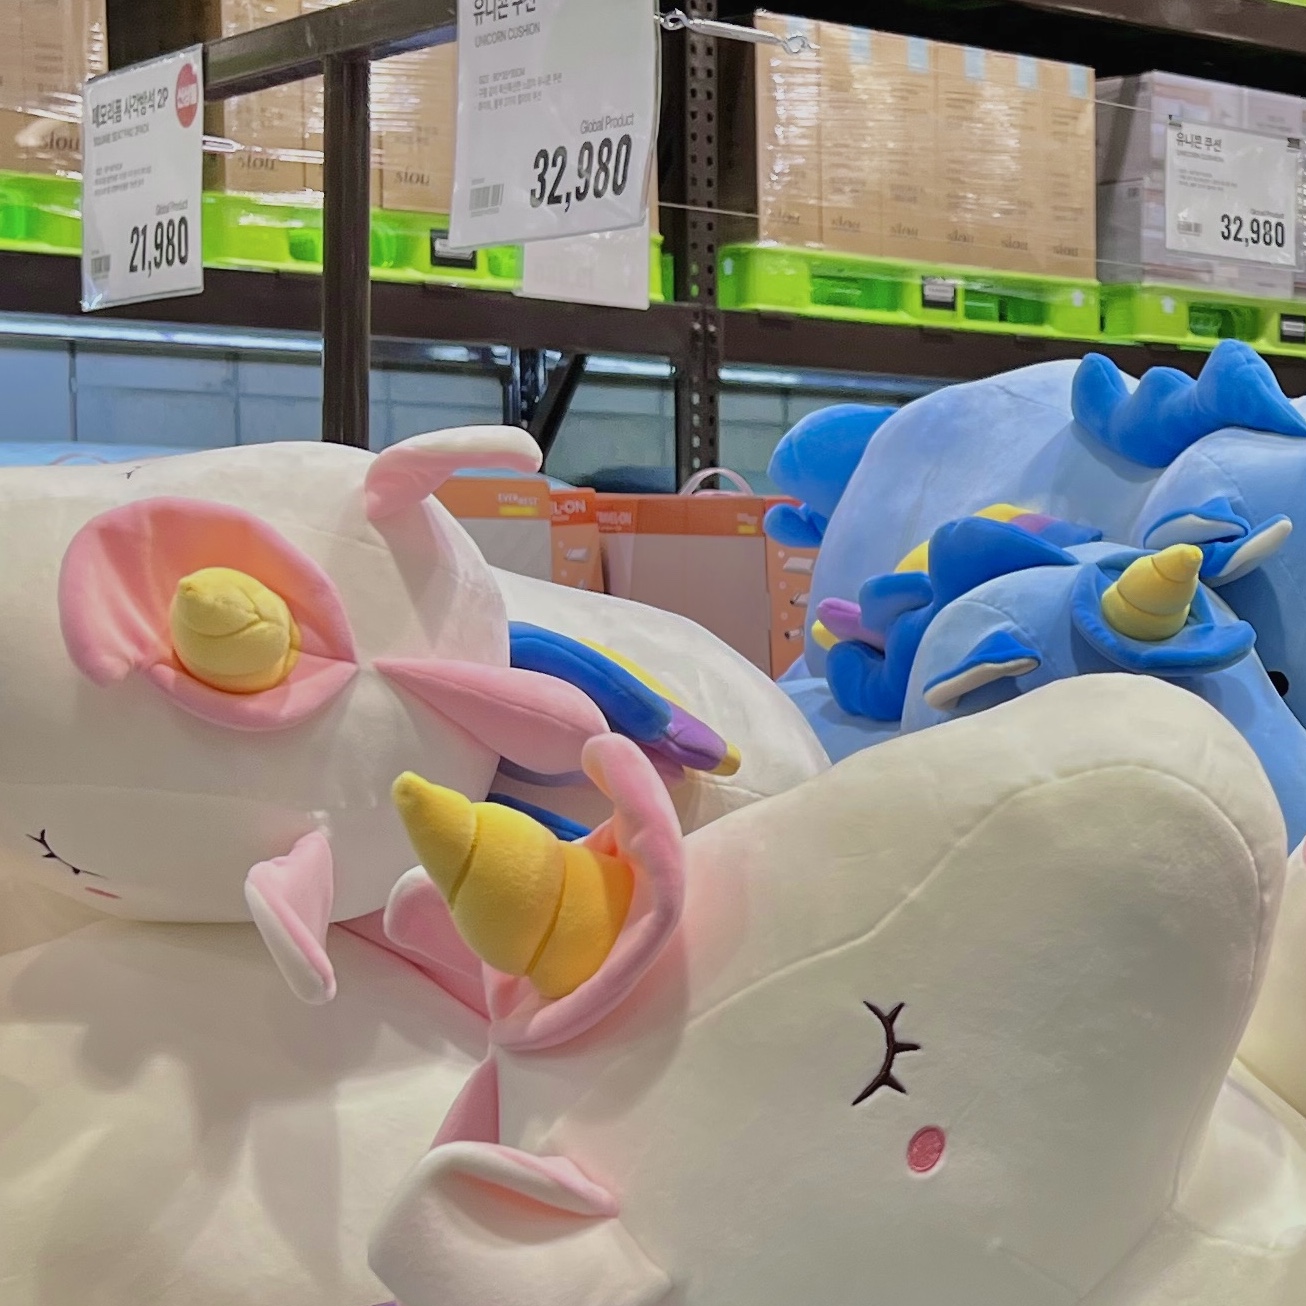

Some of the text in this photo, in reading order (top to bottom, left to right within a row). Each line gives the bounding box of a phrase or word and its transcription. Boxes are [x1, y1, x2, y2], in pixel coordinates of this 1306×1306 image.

[511, 0, 537, 16] 쿠
[474, 22, 540, 48] UNICORN CUSHION
[580, 113, 634, 134] Global Product
[530, 133, 633, 213] 32,980
[1221, 214, 1285, 247] 32,980
[129, 216, 188, 278] 21,980
